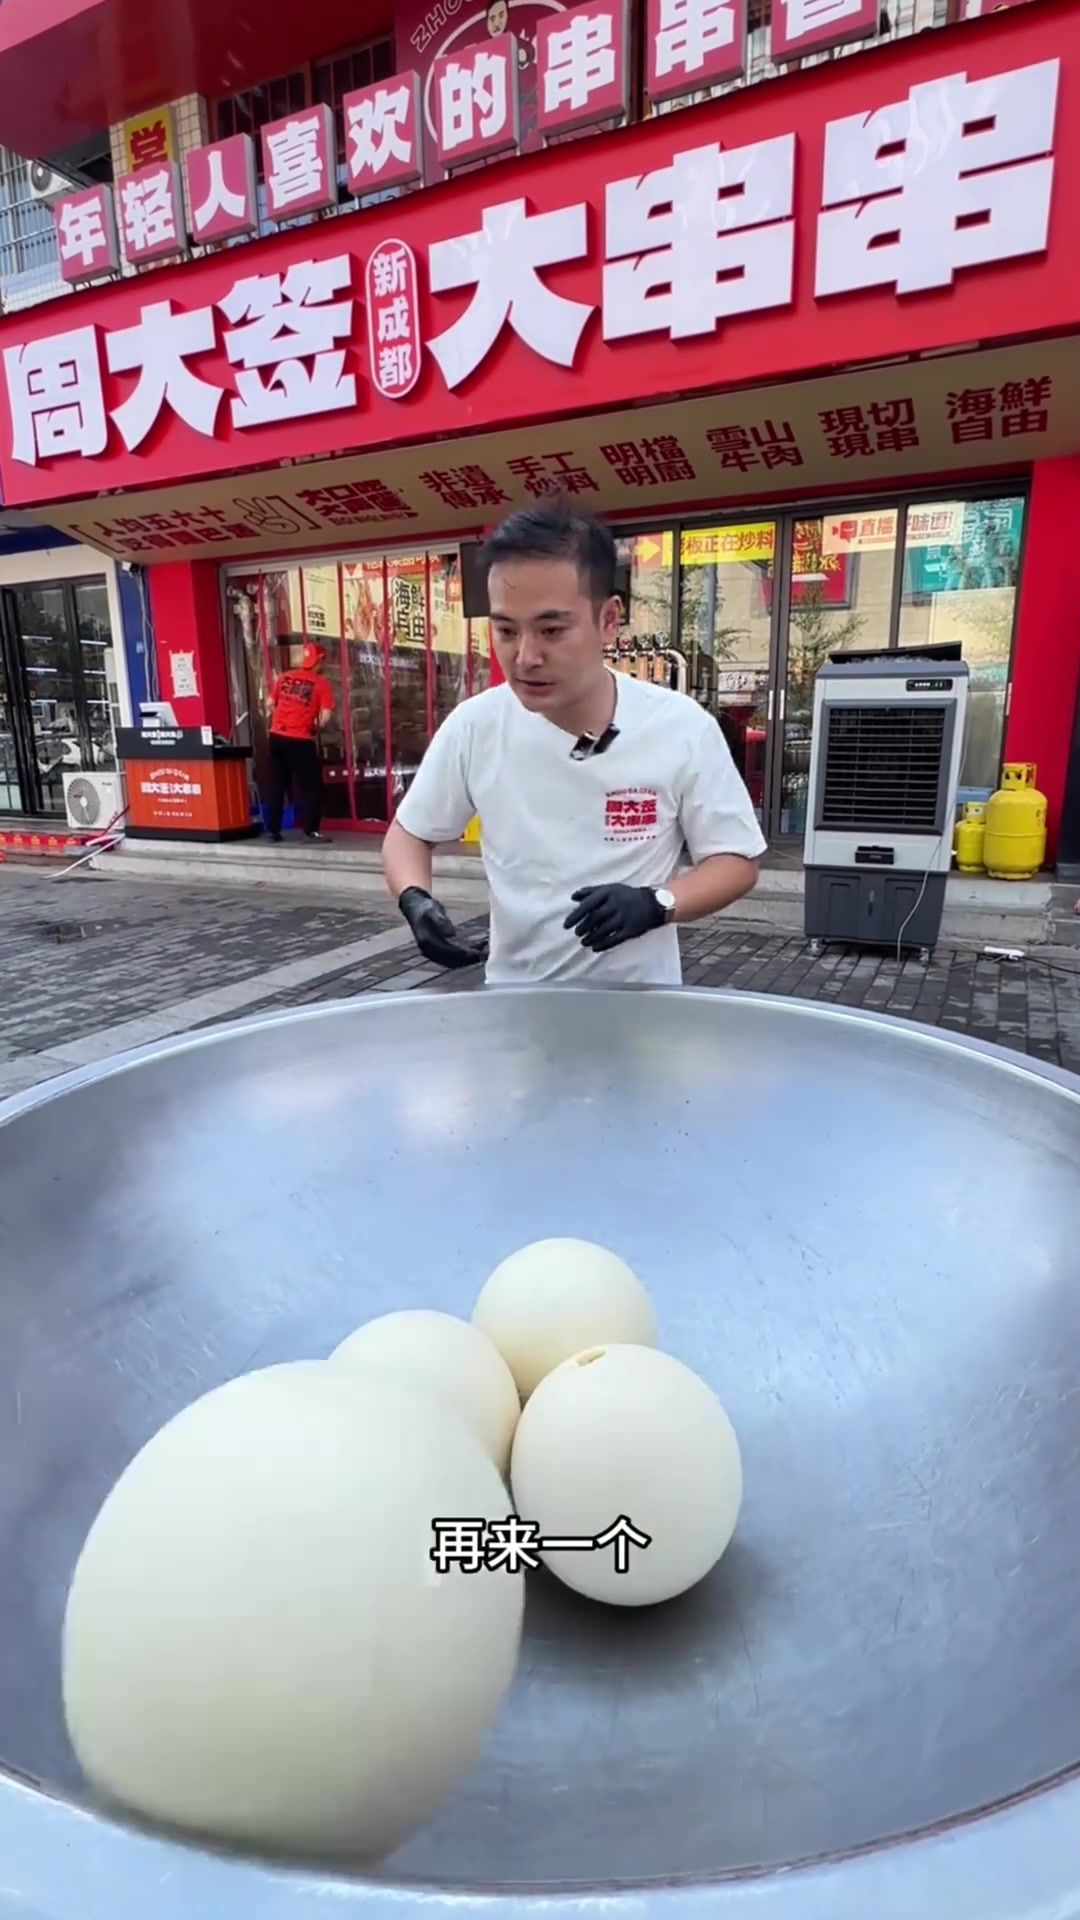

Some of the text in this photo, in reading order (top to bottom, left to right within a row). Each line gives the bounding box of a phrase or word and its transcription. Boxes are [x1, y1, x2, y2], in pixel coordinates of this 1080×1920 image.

[410, 0, 476, 54] ZHO
[3, 57, 1061, 467] 周大签 新成都 大串串
[945, 376, 1053, 419] 海鮮
[817, 398, 915, 435] 現切
[950, 409, 1048, 444] 自由
[599, 435, 686, 467] 明檔
[705, 419, 796, 451] 雪山
[827, 426, 920, 459] 現串
[506, 451, 586, 479] 手工
[614, 459, 697, 487] 明廚
[714, 444, 804, 473] 牛肉
[93, 505, 226, 537] 人均五六十
